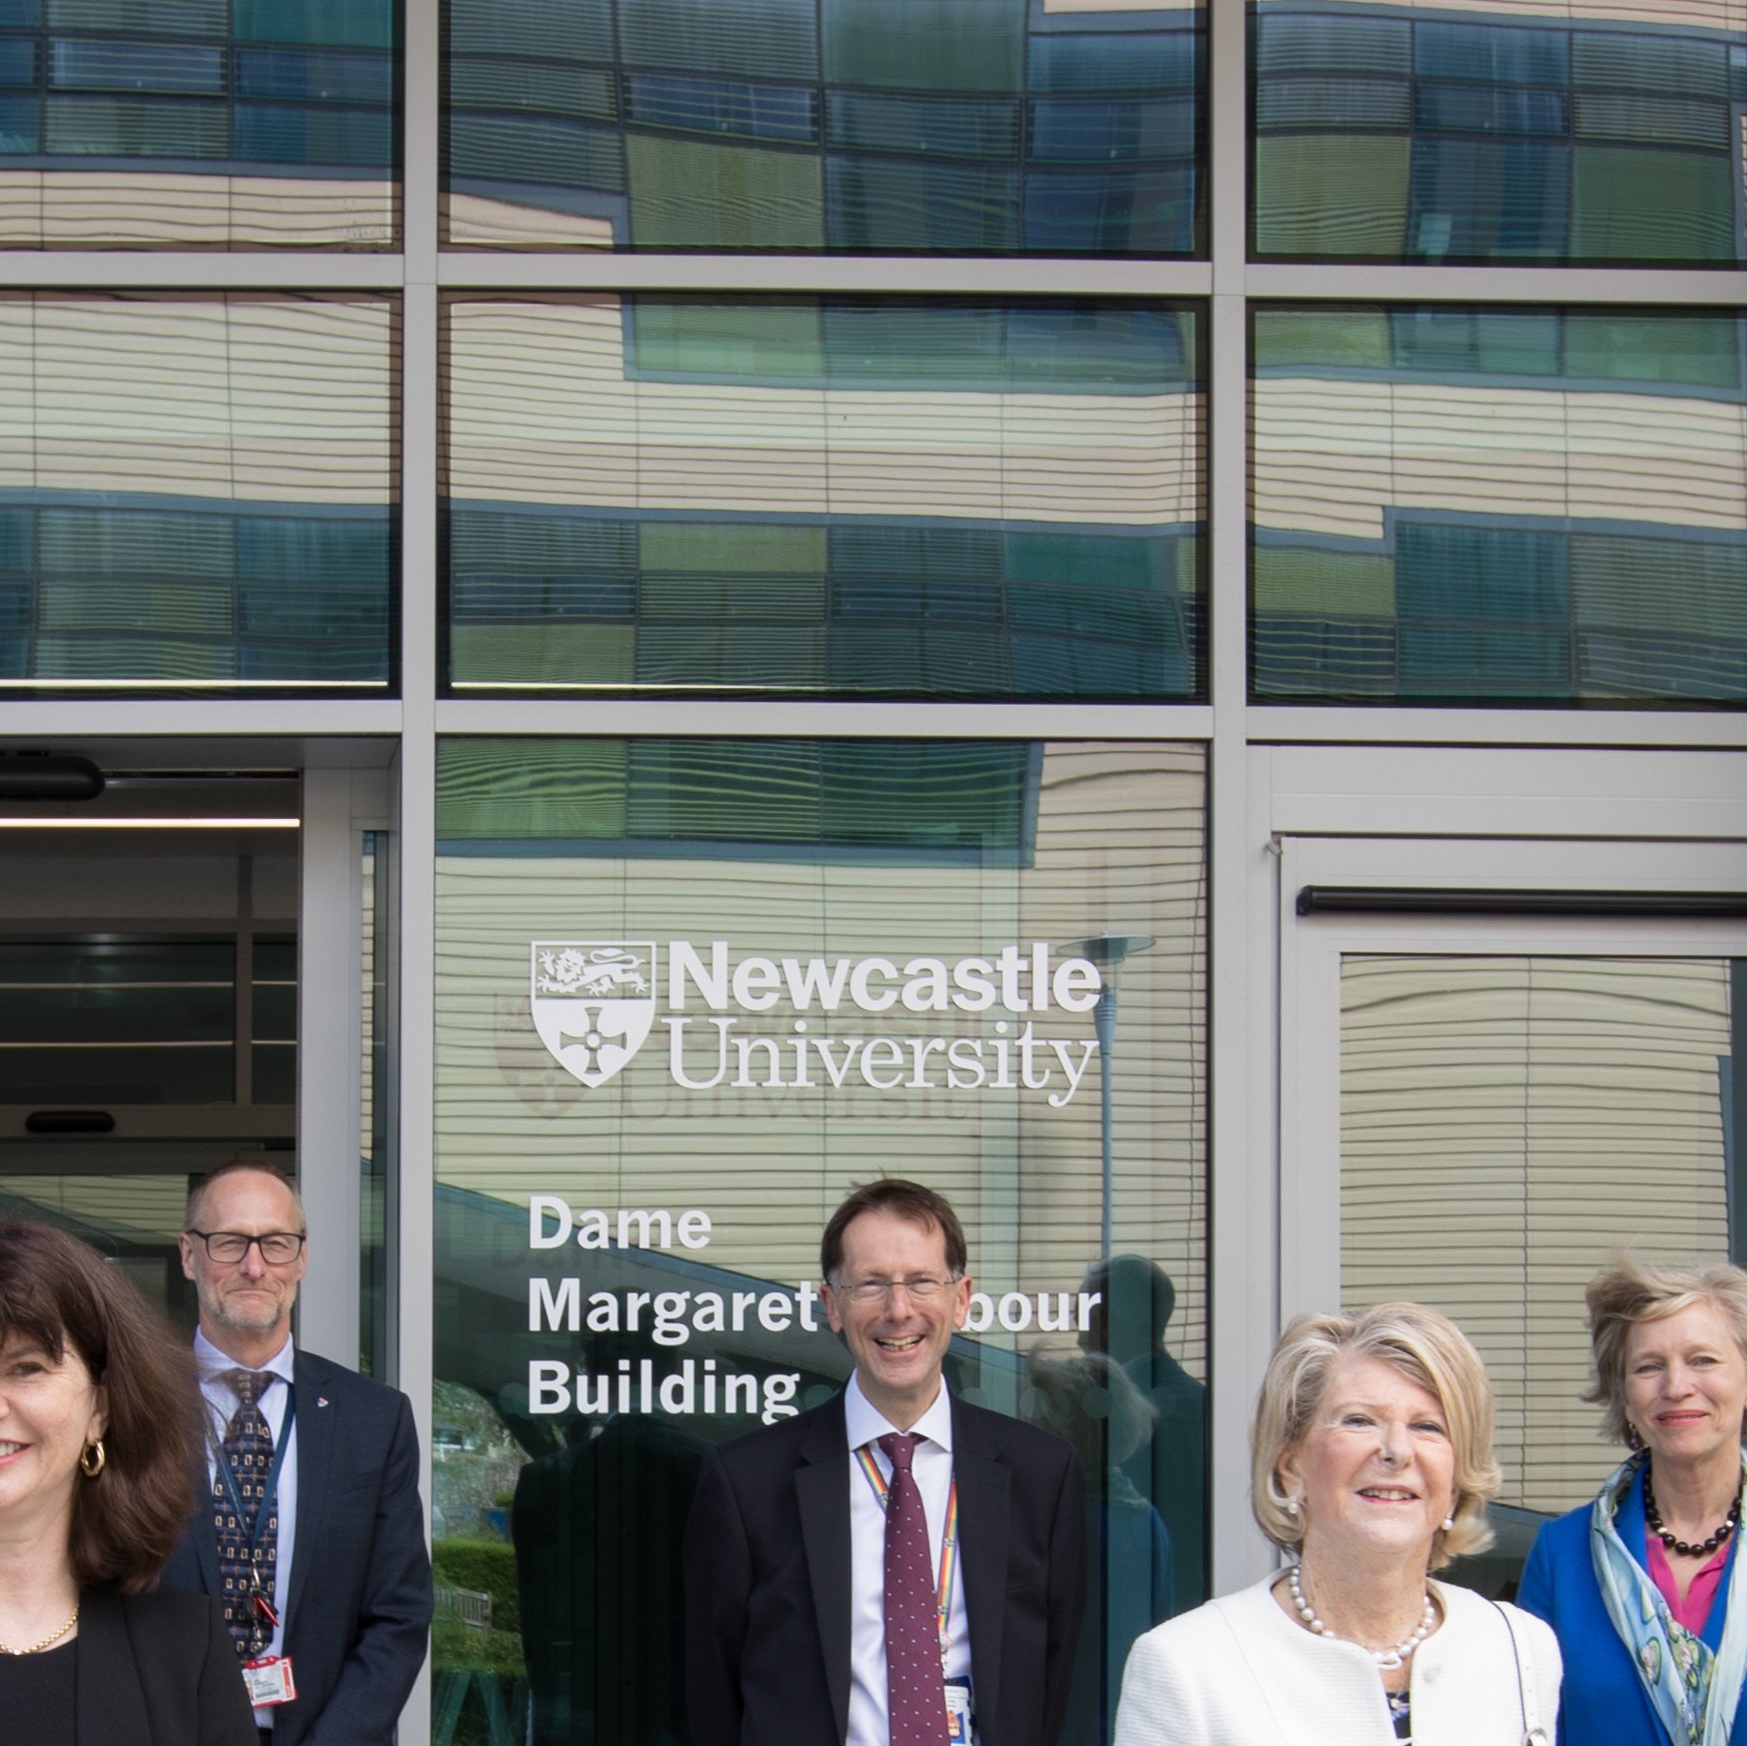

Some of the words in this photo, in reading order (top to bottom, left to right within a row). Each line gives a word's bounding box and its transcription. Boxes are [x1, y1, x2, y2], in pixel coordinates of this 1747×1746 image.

[669, 941, 1102, 1012] Newcastle
[662, 1017, 1100, 1107] University
[530, 1195, 712, 1249] Dame
[528, 1278, 818, 1345] Margaret
[960, 1291, 1102, 1331] bour
[528, 1359, 800, 1426] Building
